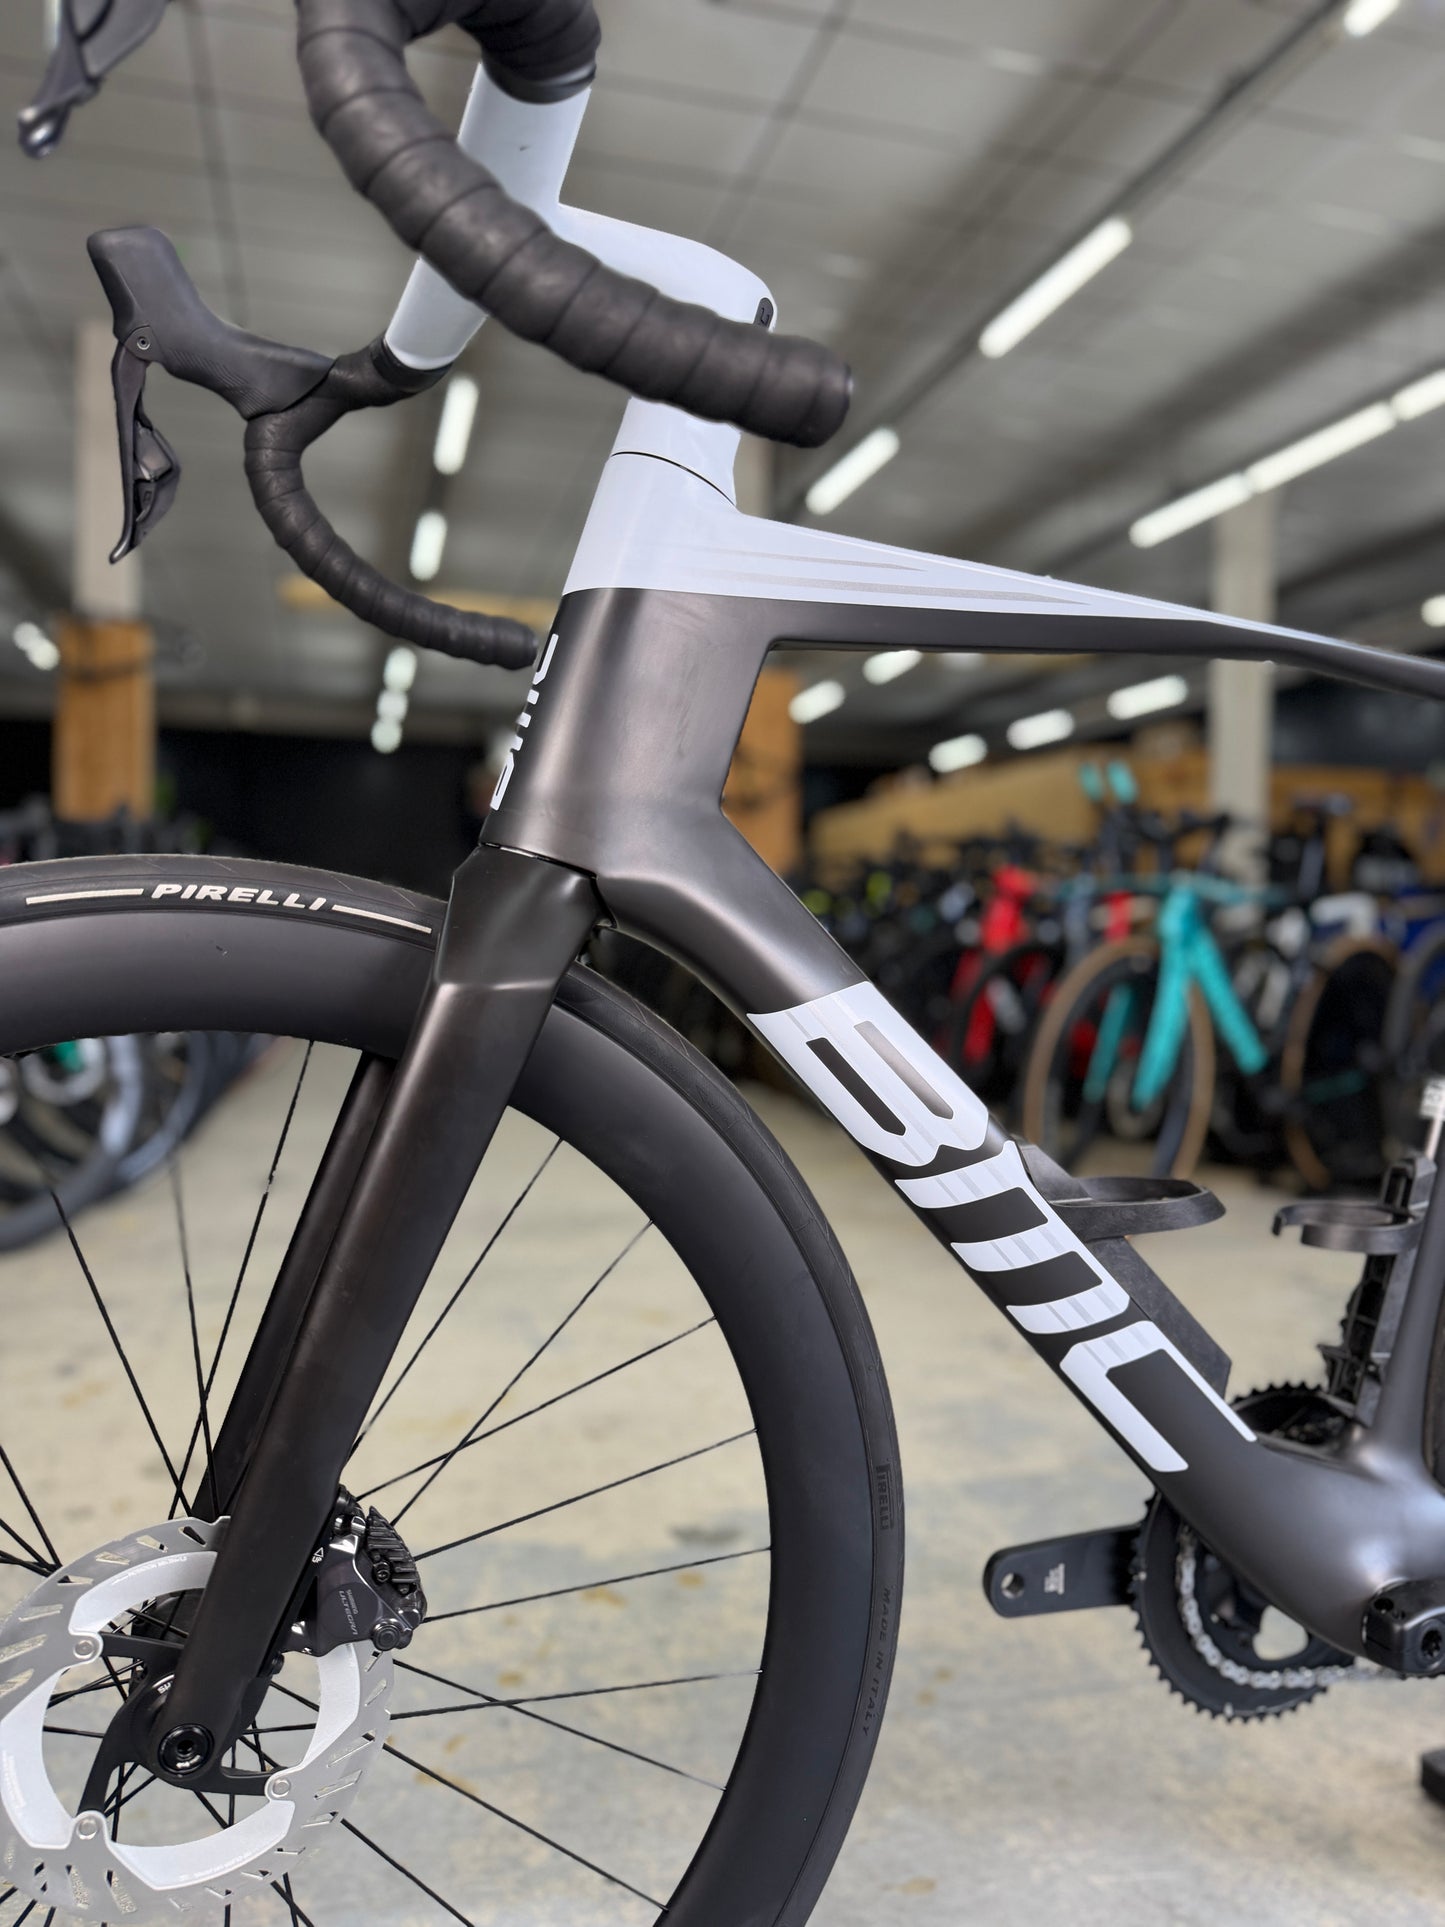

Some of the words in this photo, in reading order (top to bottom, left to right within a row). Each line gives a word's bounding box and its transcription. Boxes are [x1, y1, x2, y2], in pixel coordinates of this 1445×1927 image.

[151, 883, 329, 912] PIRELLI
[747, 981, 1258, 1473] BMC
[876, 1465, 894, 1530] PIRELLI
[339, 1590, 359, 1636] ULTEGRA
[879, 1587, 891, 1641] MADE
[875, 1650, 884, 1670] IN
[862, 1677, 880, 1737] ITALY
